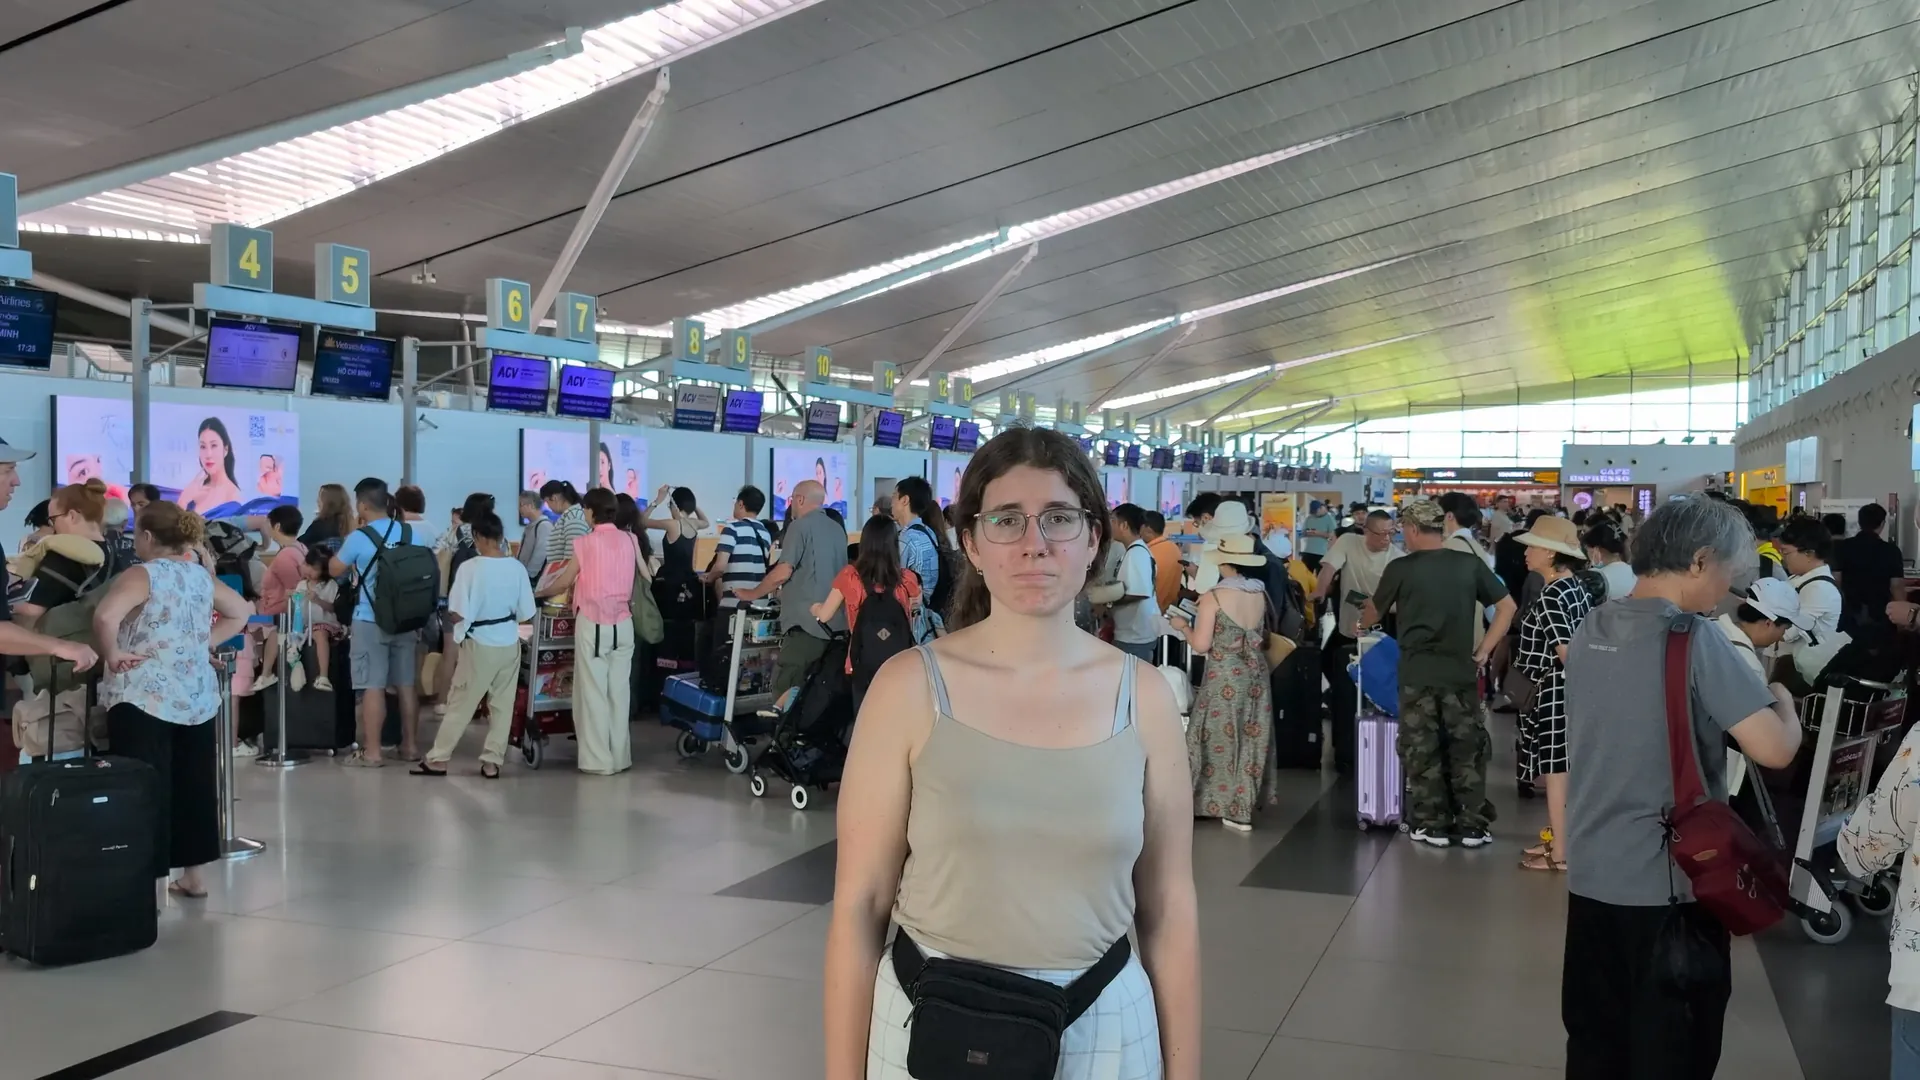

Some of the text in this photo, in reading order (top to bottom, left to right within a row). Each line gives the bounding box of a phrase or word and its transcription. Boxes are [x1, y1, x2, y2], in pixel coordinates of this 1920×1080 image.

[239, 238, 261, 279] 4
[342, 256, 359, 294] 5
[508, 289, 523, 323] 6
[575, 302, 588, 333] 7
[690, 327, 700, 355] 8
[736, 336, 746, 364] 9
[497, 366, 519, 379] ACV
[817, 355, 829, 377] 10
[566, 375, 586, 387] ACV
[885, 369, 894, 389] 11
[938, 378, 948, 397] 12
[681, 393, 698, 404] ACV
[963, 383, 972, 402] 13
[729, 398, 744, 408] ACV
[1600, 468, 1630, 476] CAFE
